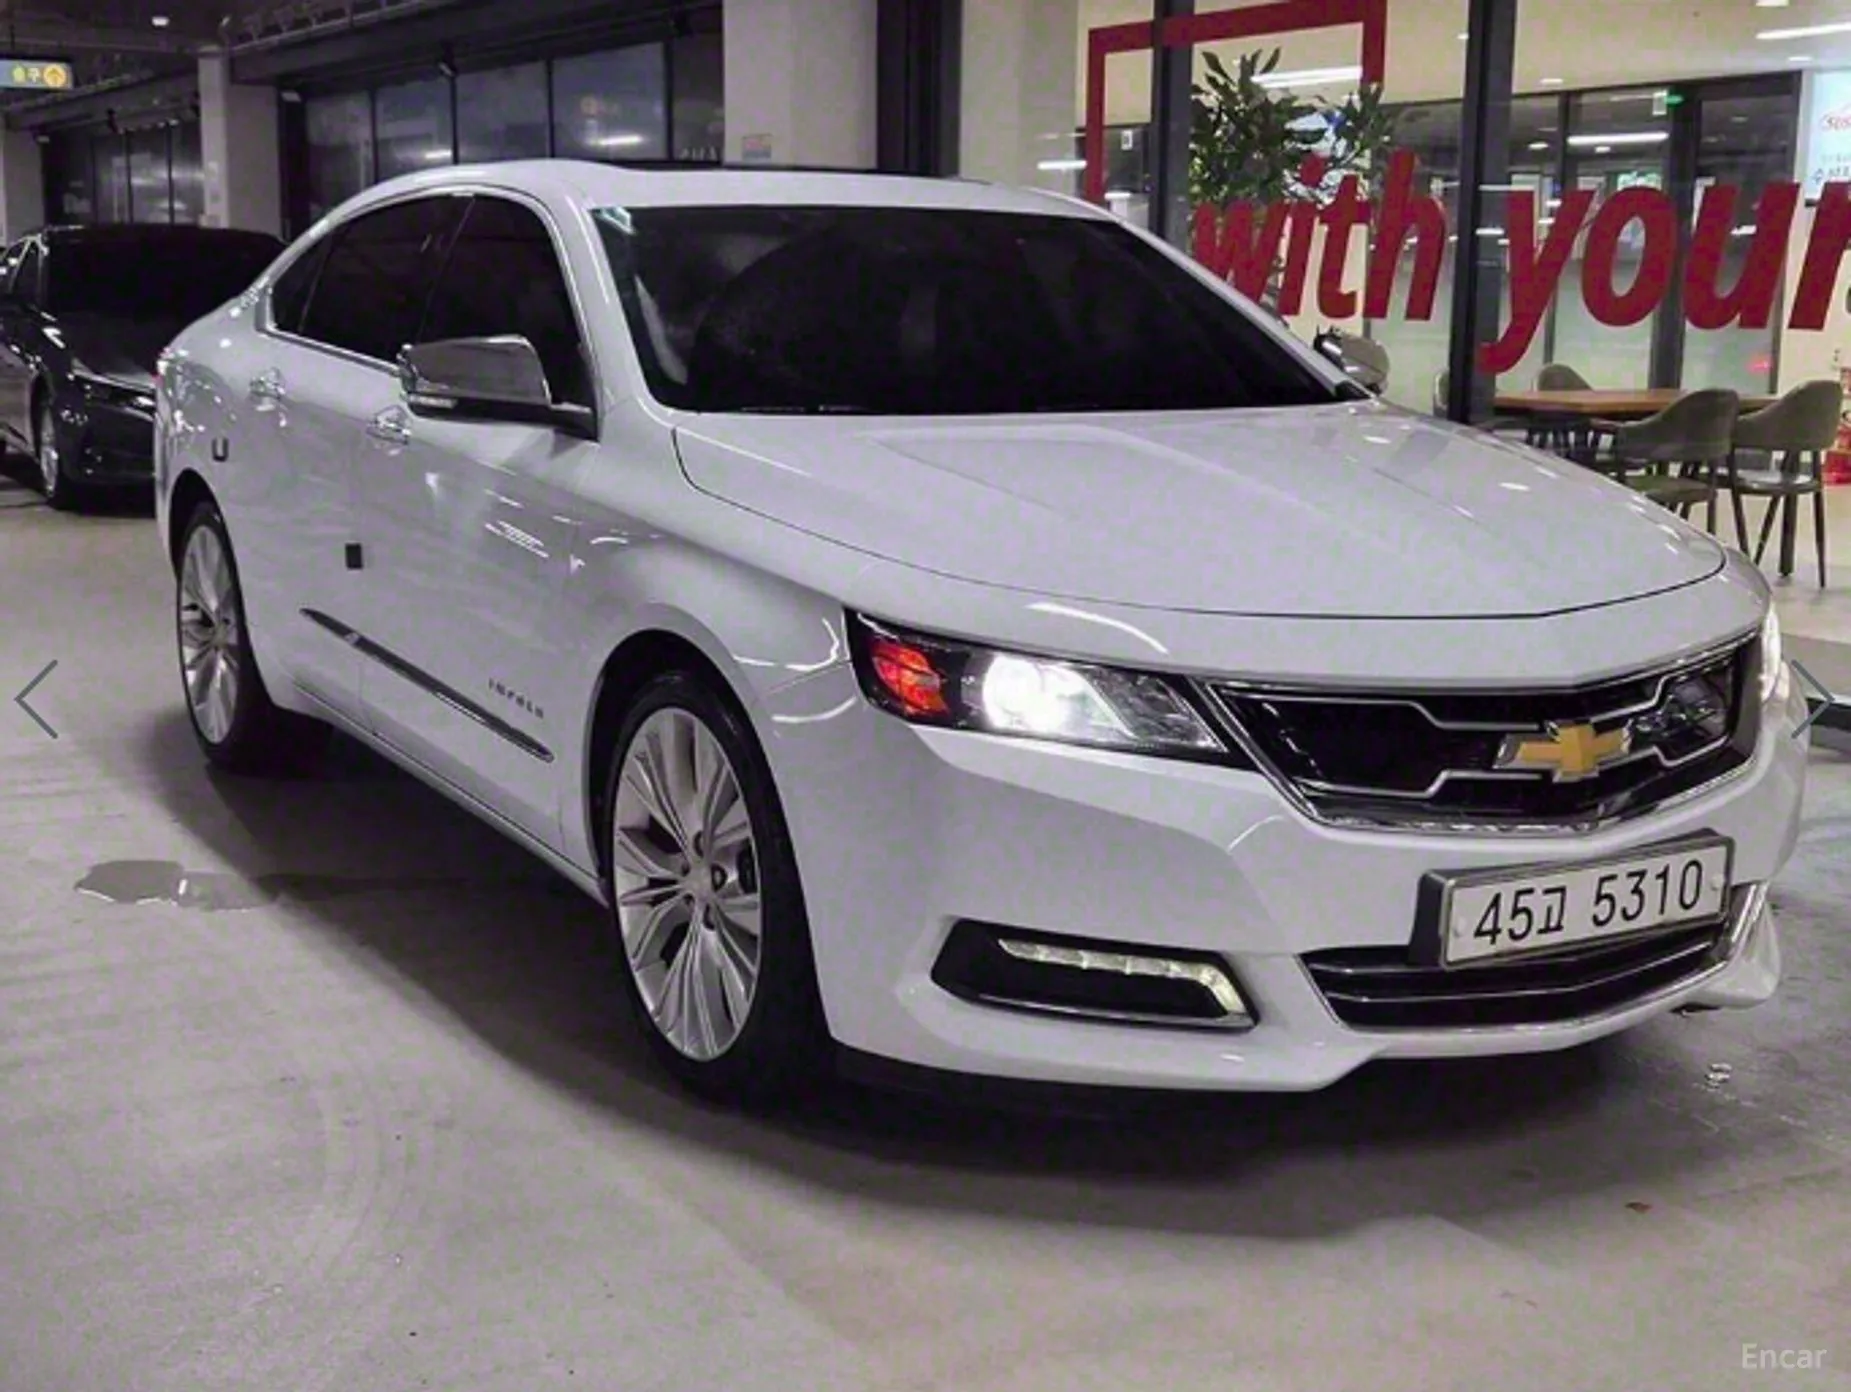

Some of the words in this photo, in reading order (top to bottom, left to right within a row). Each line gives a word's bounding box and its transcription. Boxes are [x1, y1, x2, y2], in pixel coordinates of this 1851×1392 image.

[1192, 146, 1446, 321] with
[1477, 182, 1851, 374] your
[1473, 885, 1568, 945] 45고
[1591, 859, 1703, 928] 5310
